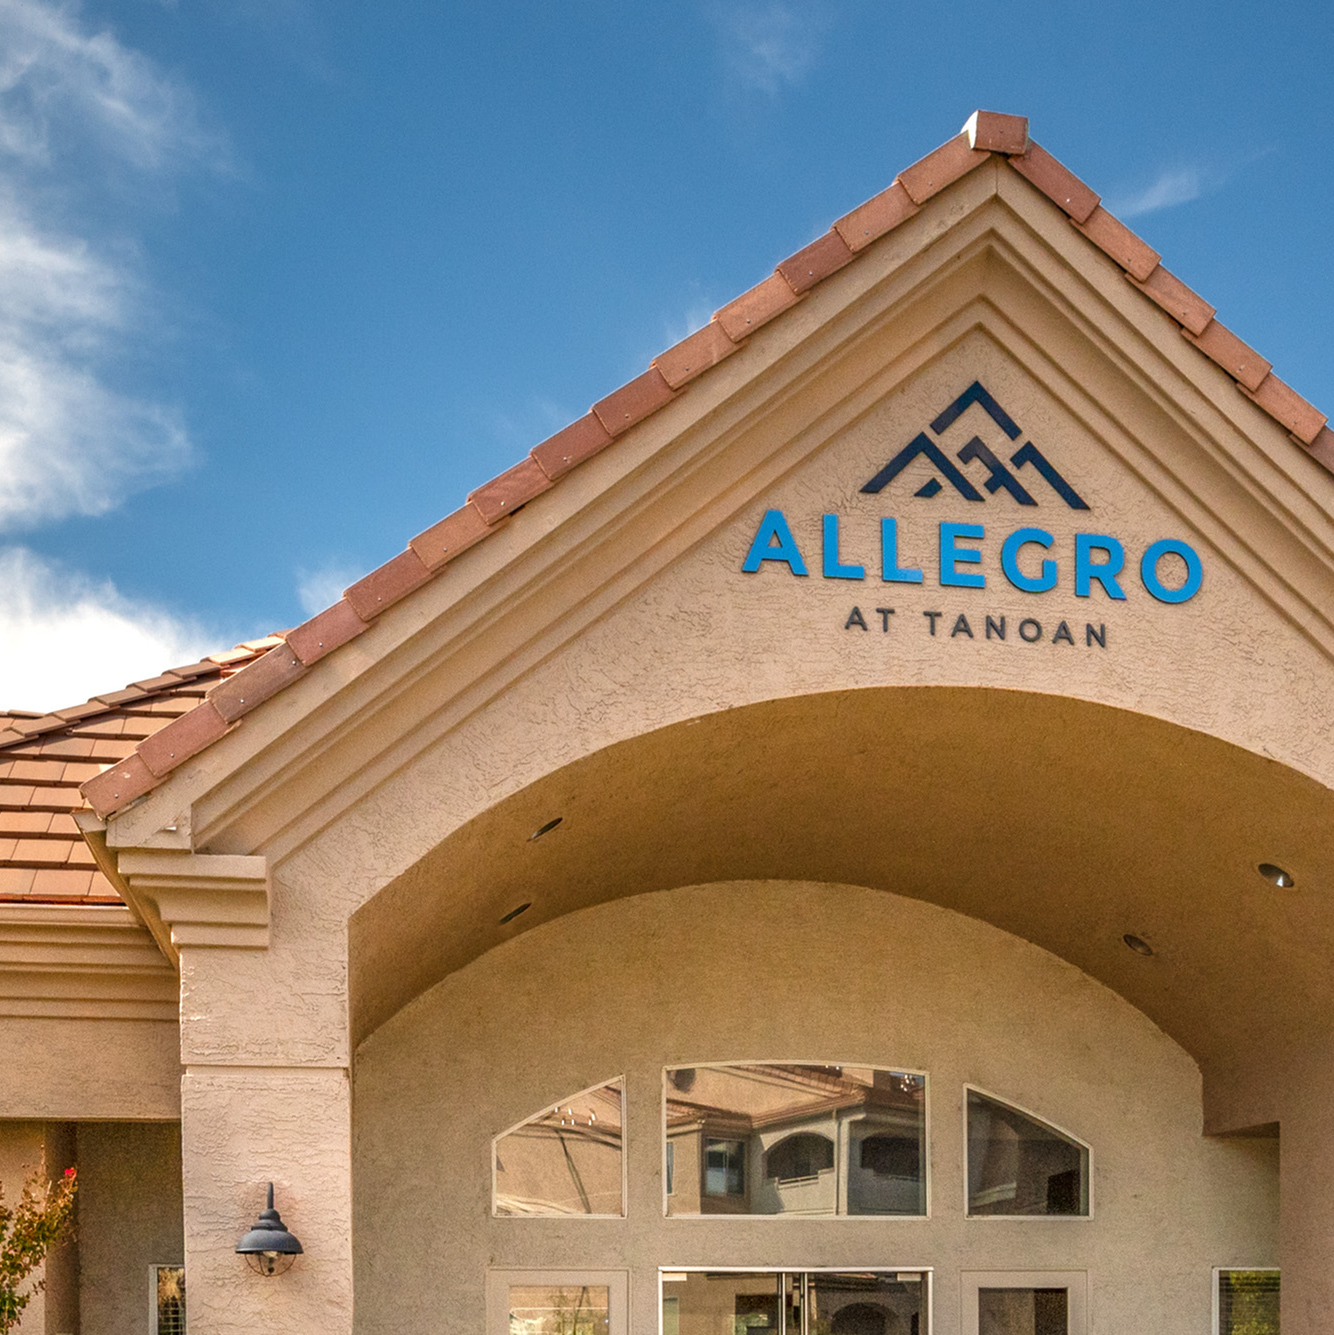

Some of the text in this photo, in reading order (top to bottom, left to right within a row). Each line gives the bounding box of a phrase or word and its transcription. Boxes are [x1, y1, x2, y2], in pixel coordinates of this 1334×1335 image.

[741, 508, 1204, 605] ALLEGRO
[844, 605, 1107, 648] AT TANOAN
